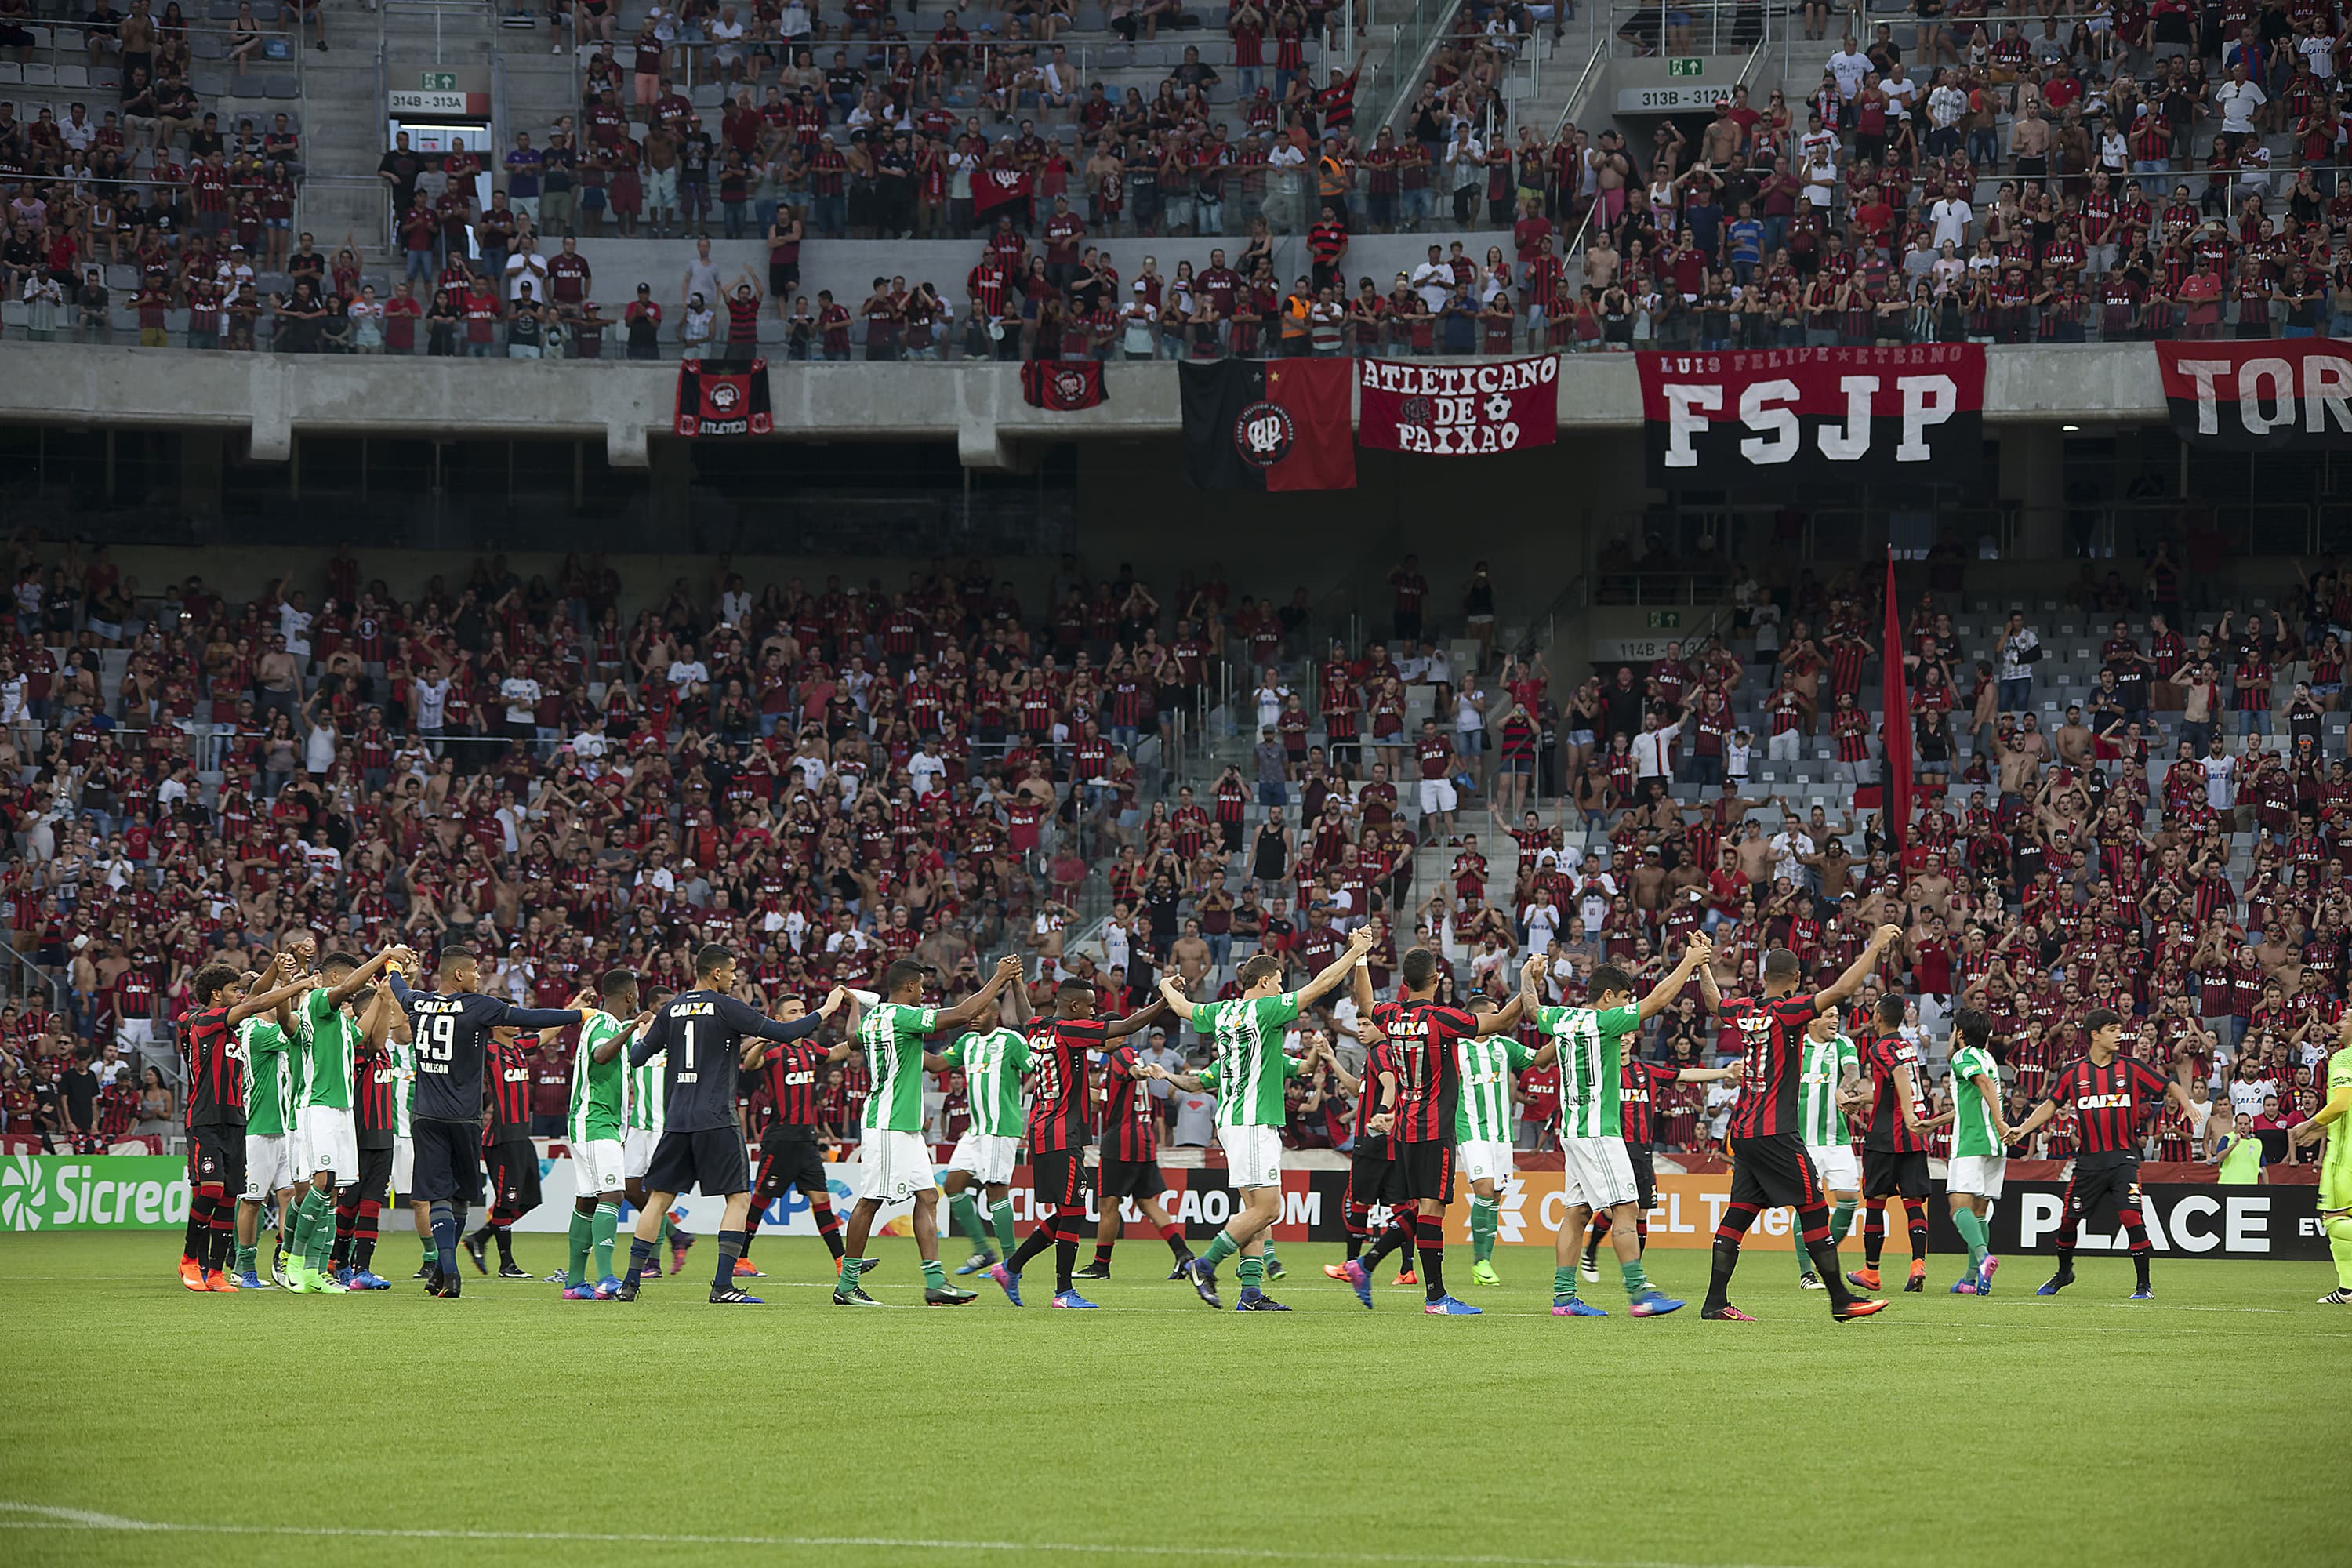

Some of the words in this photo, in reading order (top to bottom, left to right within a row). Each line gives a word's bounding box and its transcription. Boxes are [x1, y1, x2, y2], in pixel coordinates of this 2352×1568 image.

[393, 96, 421, 107] 314B
[433, 96, 462, 107] 313A
[1642, 93, 1679, 105] 313B
[1693, 89, 1729, 104] 312A
[557, 270, 581, 278] CAIXA
[1208, 281, 1230, 289] CAIXA
[1661, 356, 1722, 374] LUIS
[1734, 347, 1830, 372] FELIPE
[1856, 345, 1963, 365] ETERNO
[1433, 397, 1477, 426] DE
[1396, 422, 1520, 455] PAIXÃO
[1621, 643, 1655, 656] 114B
[2266, 800, 2288, 810] CAIXA
[1306, 944, 1331, 955] CAIXA
[2236, 981, 2259, 990] CAIXA
[414, 1000, 463, 1013] CAIXA
[670, 1003, 714, 1018] CAIXA
[1388, 1021, 1429, 1036] CAIXA
[416, 1014, 455, 1061] 49
[684, 1020, 695, 1069] 1
[540, 1076, 565, 1085] CAIXA
[1527, 1085, 1554, 1094] CAIXA
[2077, 1094, 2132, 1110] CAIXA
[53, 1165, 191, 1224] Sicred
